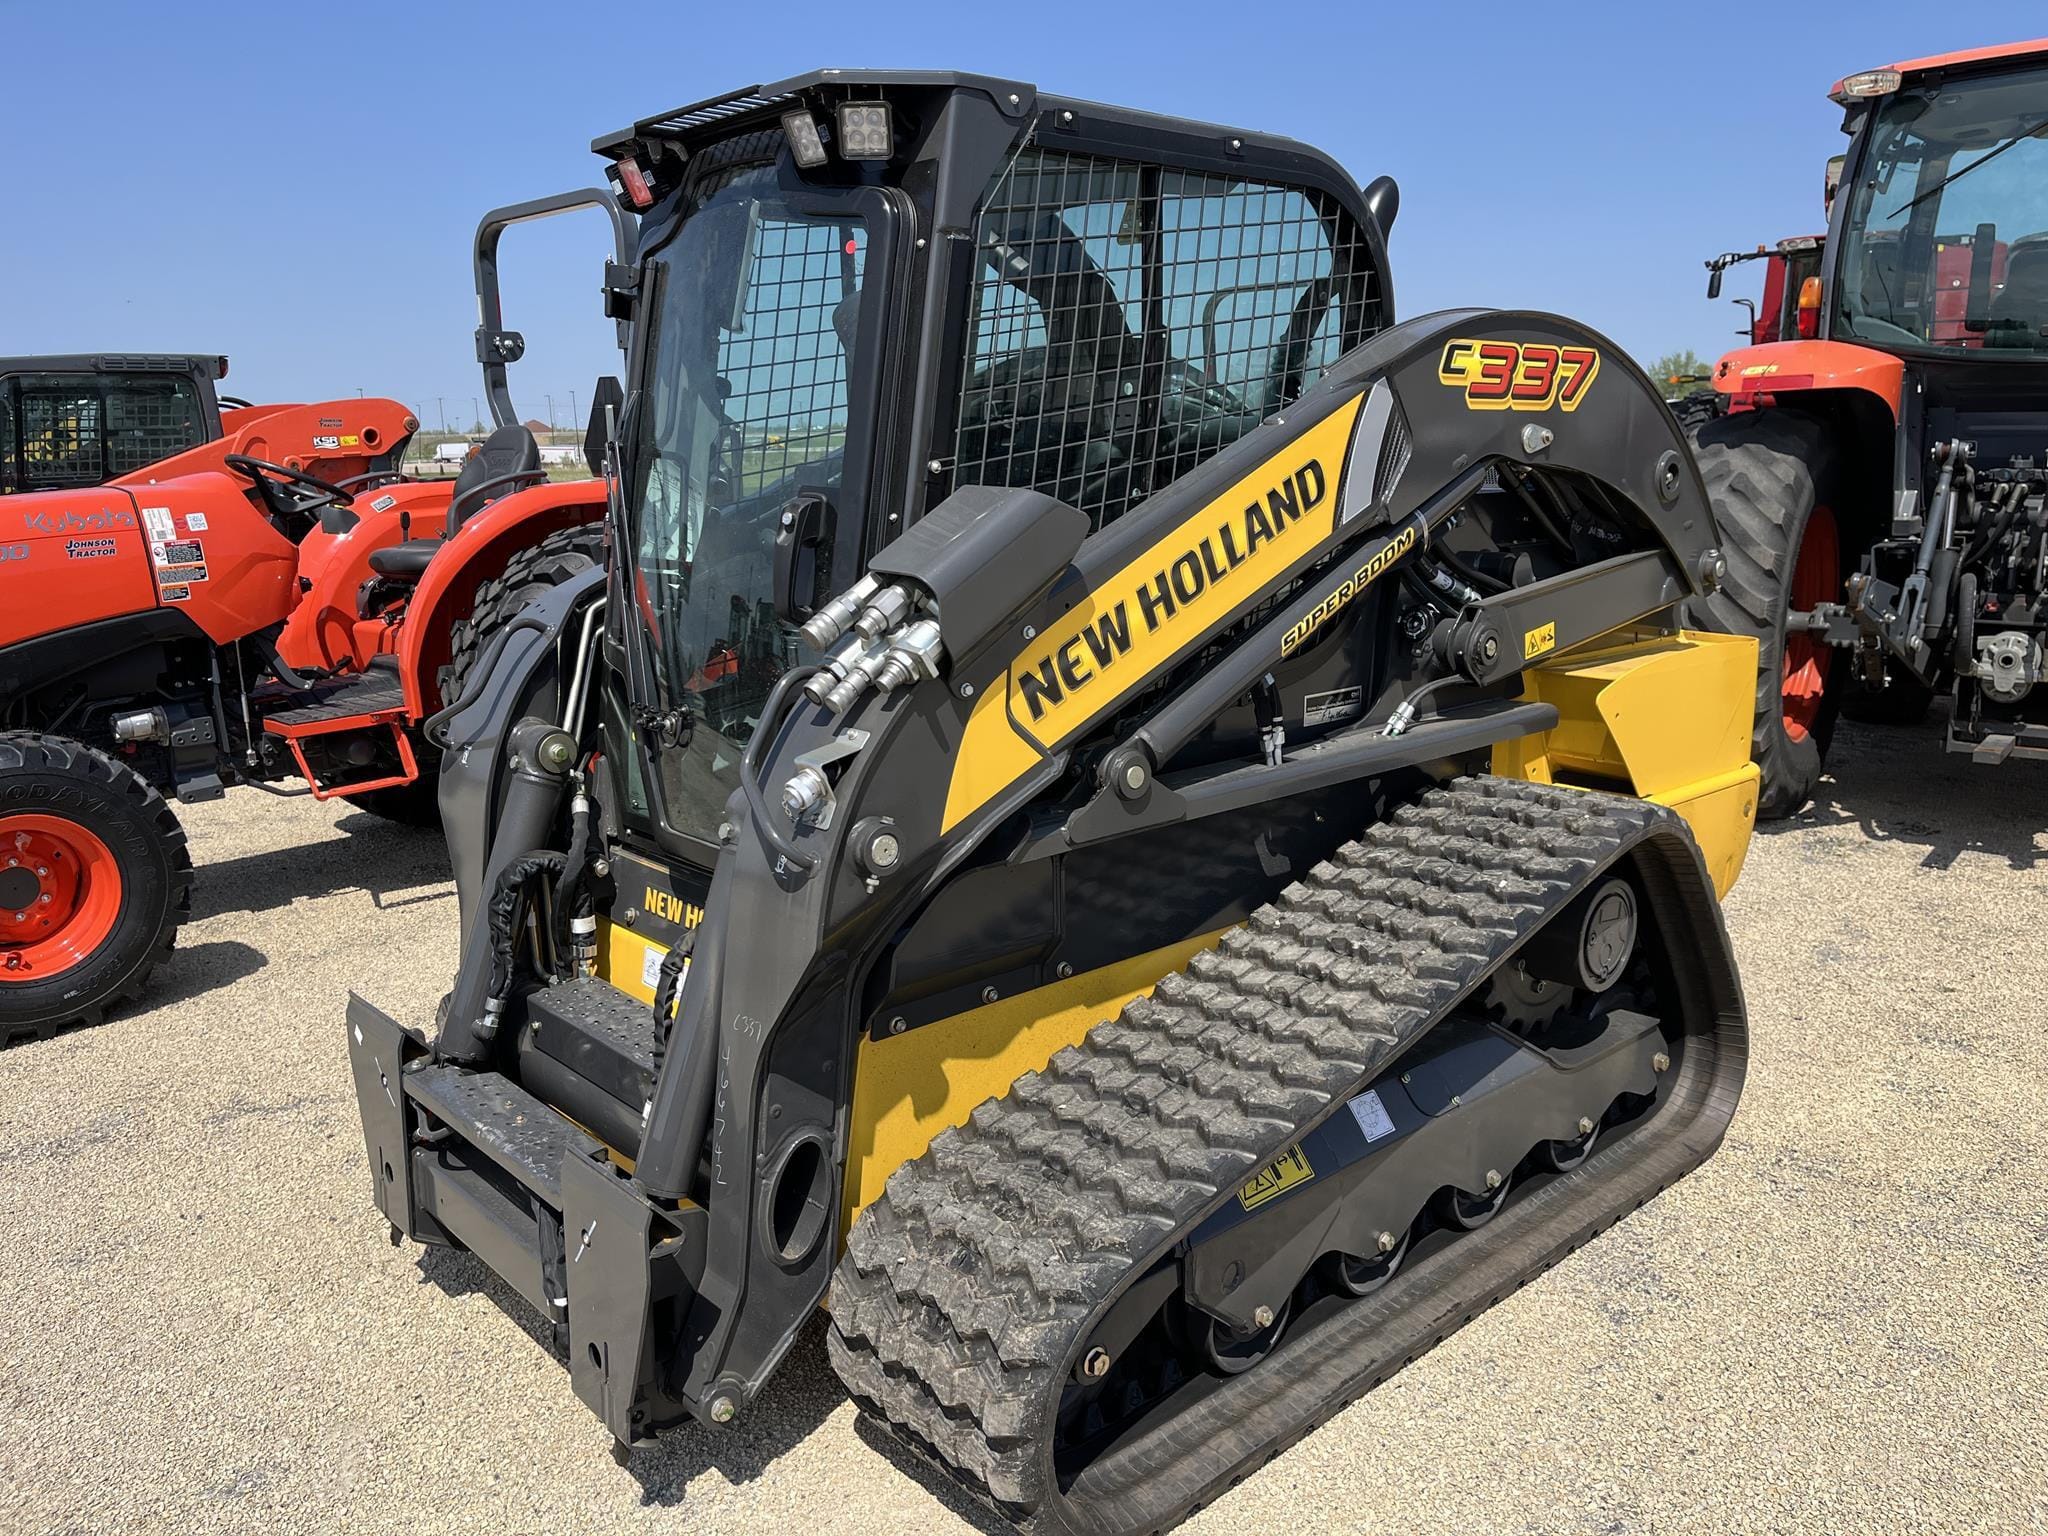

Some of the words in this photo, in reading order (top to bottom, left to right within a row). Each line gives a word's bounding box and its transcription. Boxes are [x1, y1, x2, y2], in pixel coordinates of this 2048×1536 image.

[1439, 339, 1600, 410] C337
[24, 506, 134, 533] Kubota
[65, 539, 115, 549] JOHNSON
[67, 548, 116, 558] TRACTOR
[1018, 600, 1132, 722] NEW
[1136, 458, 1327, 633] HOLLAND
[1282, 580, 1354, 656] SUPER
[1355, 528, 1414, 593] BOOM
[644, 886, 683, 925] NEW
